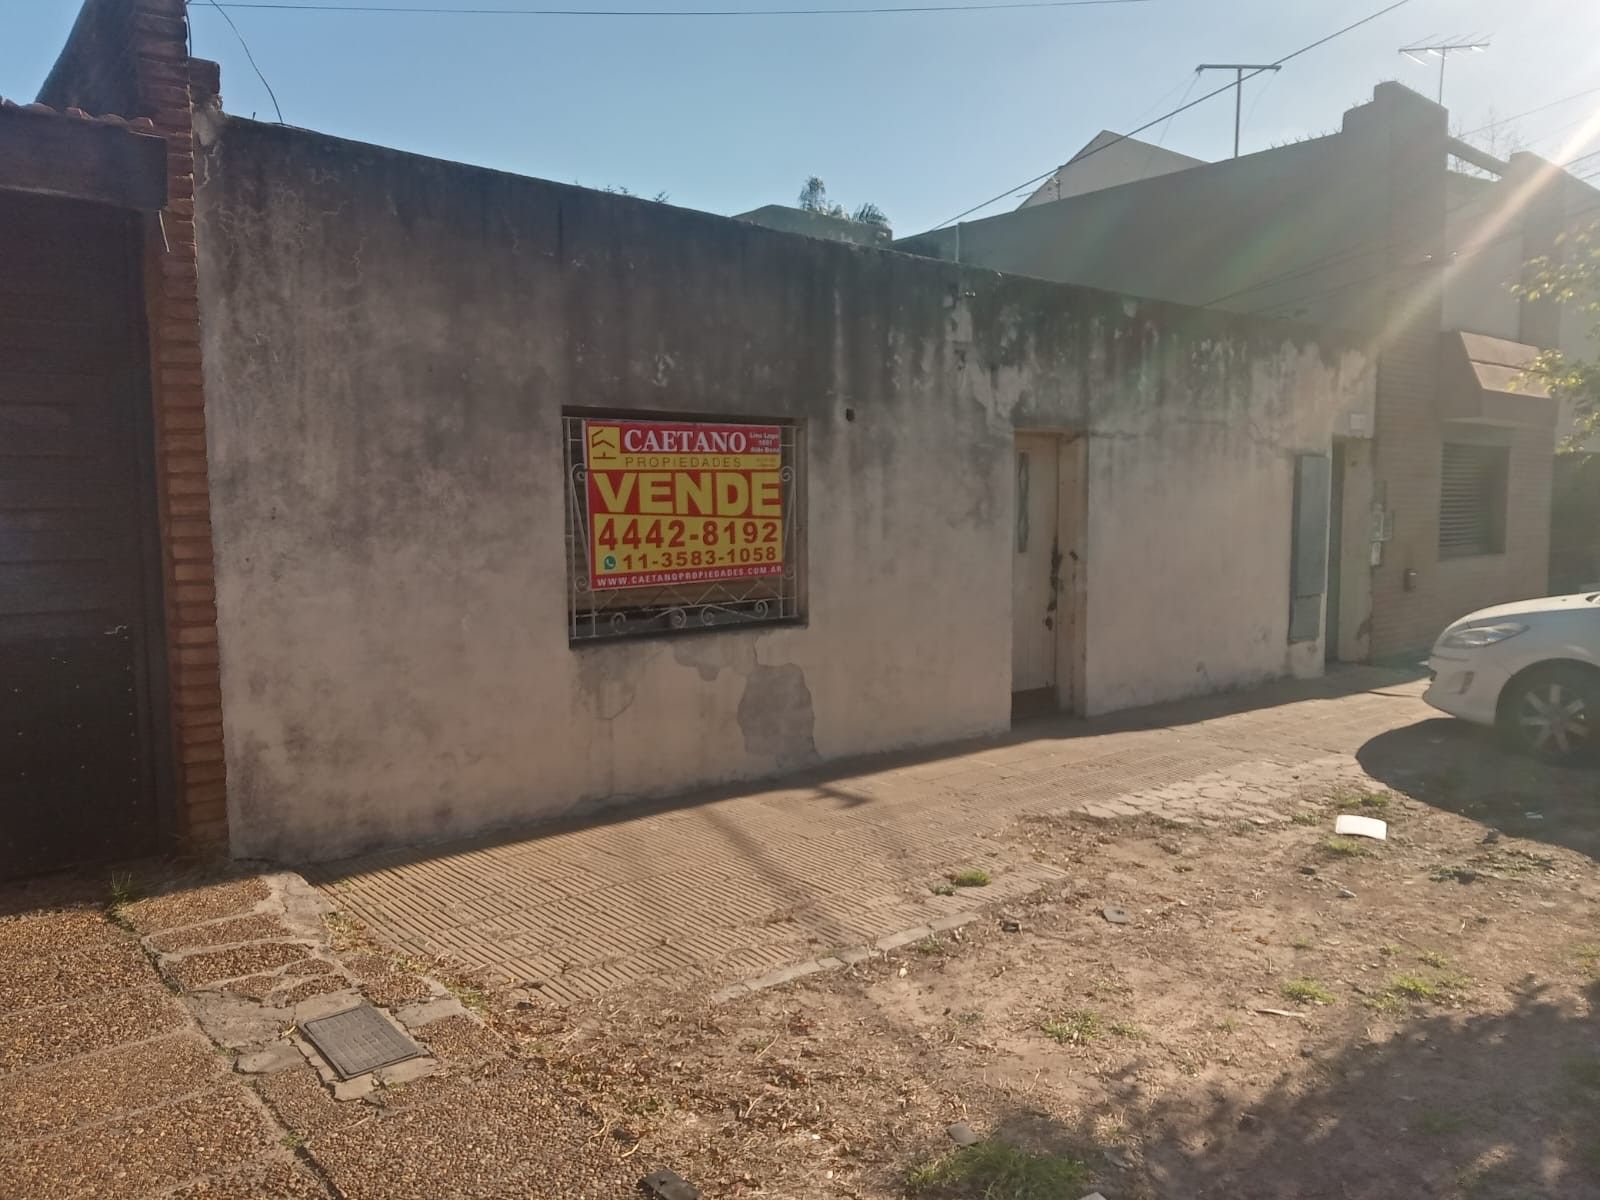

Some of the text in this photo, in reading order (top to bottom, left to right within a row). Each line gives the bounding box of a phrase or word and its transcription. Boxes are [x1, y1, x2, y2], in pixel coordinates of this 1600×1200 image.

[624, 429, 747, 453] CAETANO
[625, 456, 742, 468] PROPIEDADES
[593, 472, 781, 516] VENDE
[598, 518, 778, 551] 4442-8192
[623, 546, 777, 570] 11-3583-1058
